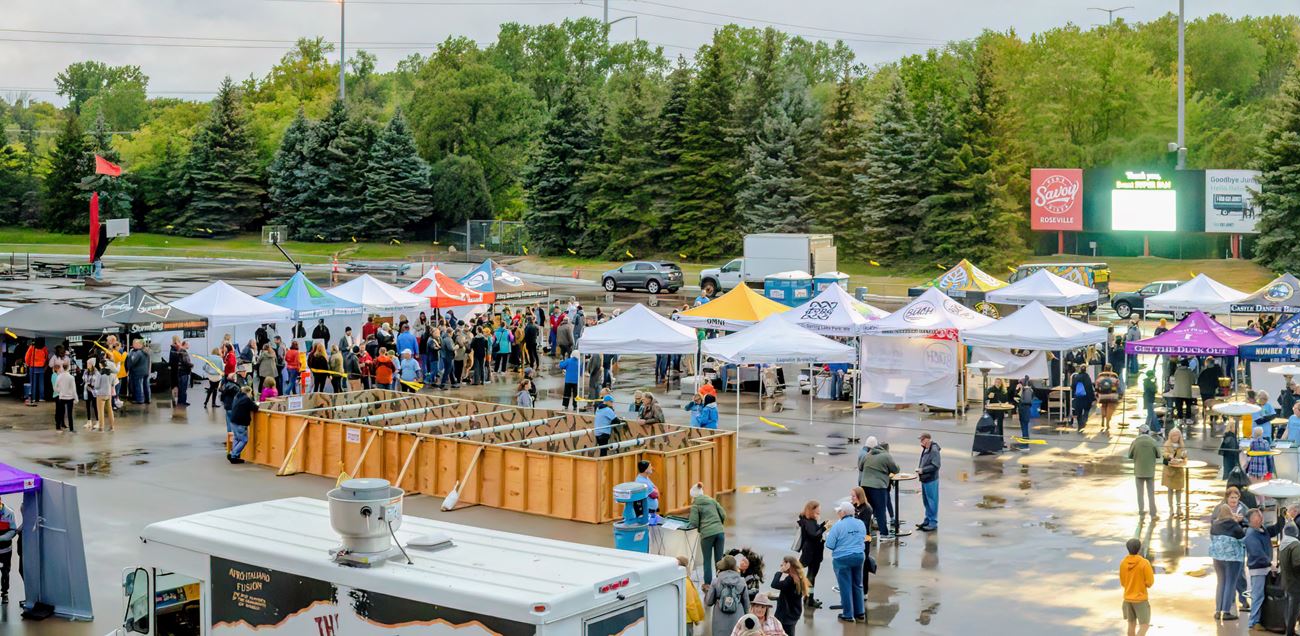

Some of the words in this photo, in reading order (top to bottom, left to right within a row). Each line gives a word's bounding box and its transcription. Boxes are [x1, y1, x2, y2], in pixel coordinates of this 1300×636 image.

[1211, 176, 1239, 184] Goodbye
[1035, 180, 1079, 207] Savoy
[706, 318, 725, 326] OMNI
[131, 321, 163, 333] StormKing
[1177, 346, 1204, 354] DUCK
[236, 582, 263, 592] FUSION
